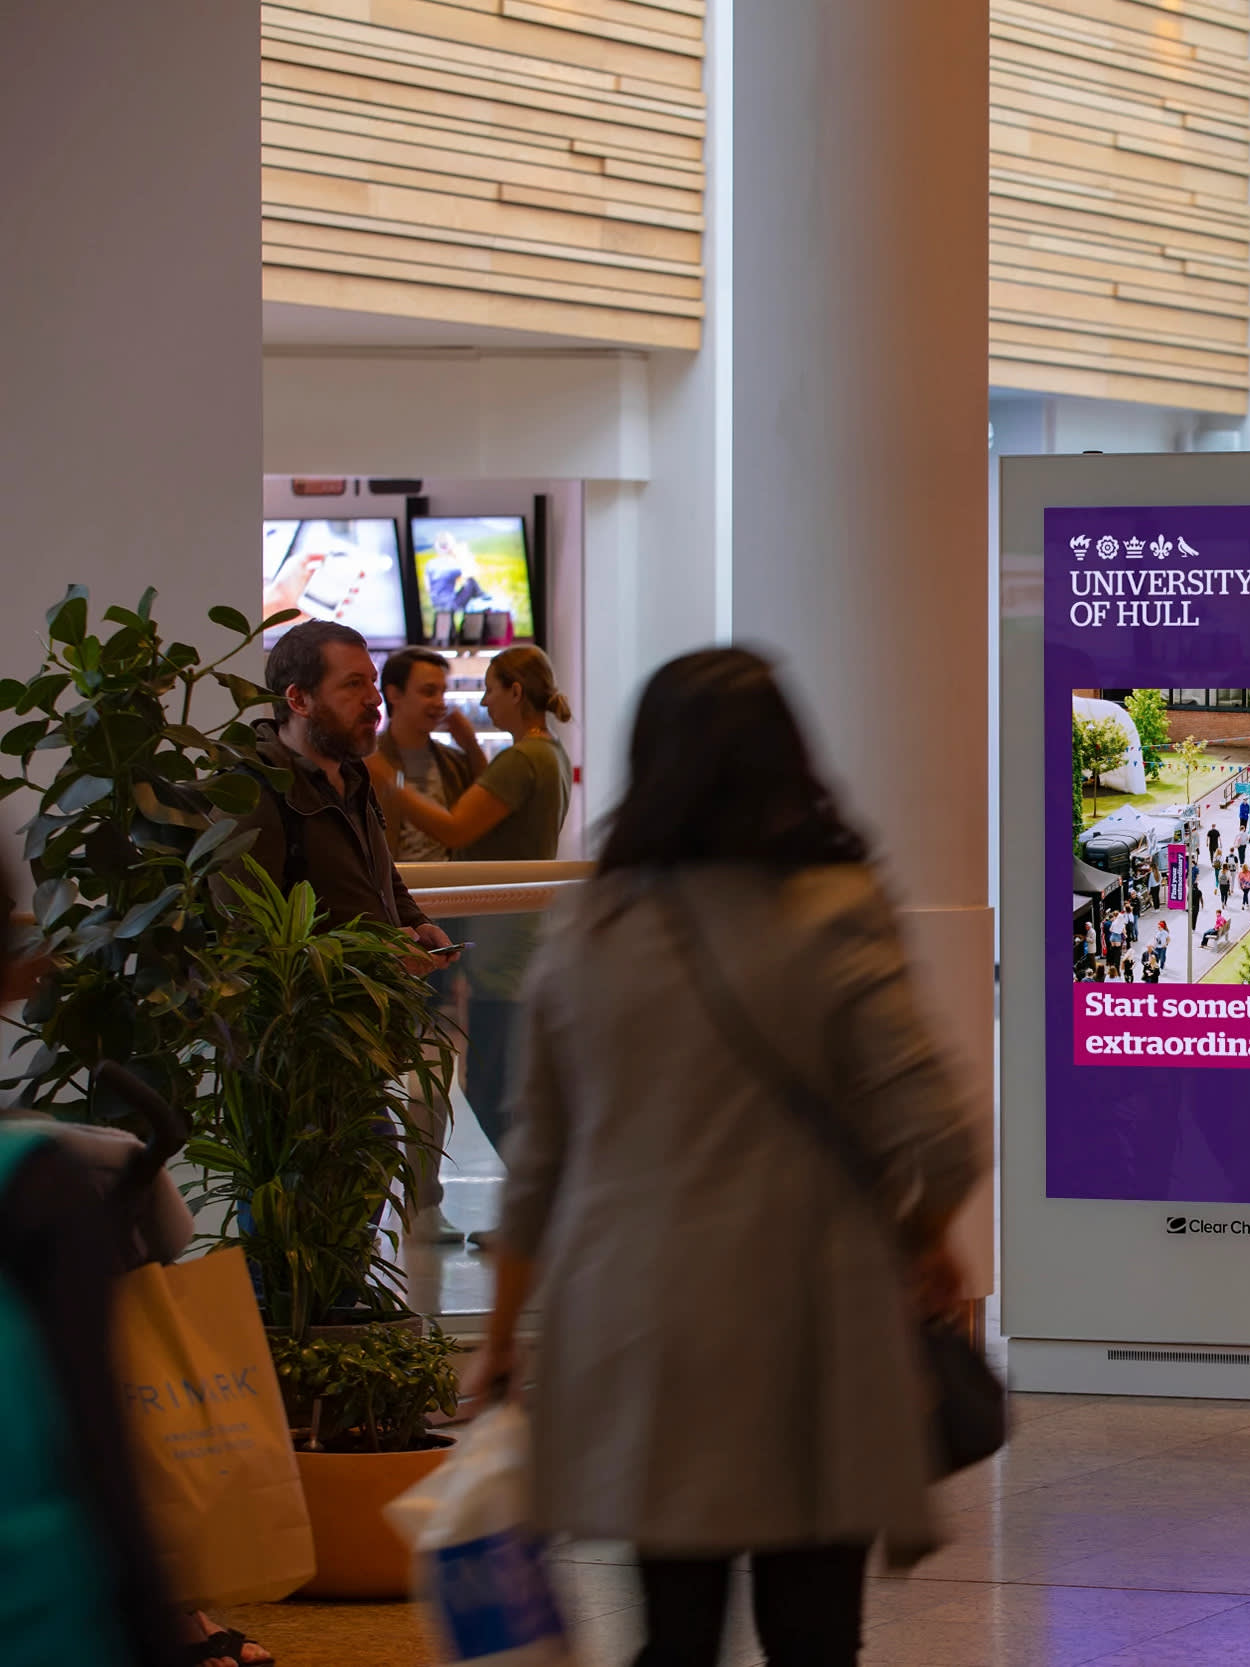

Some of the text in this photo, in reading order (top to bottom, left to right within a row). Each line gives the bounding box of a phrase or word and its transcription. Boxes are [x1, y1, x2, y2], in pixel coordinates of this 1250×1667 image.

[1069, 600, 1200, 627] OF HULL
[1085, 991, 1158, 1018] Start
[1189, 1219, 1228, 1235] Clear
